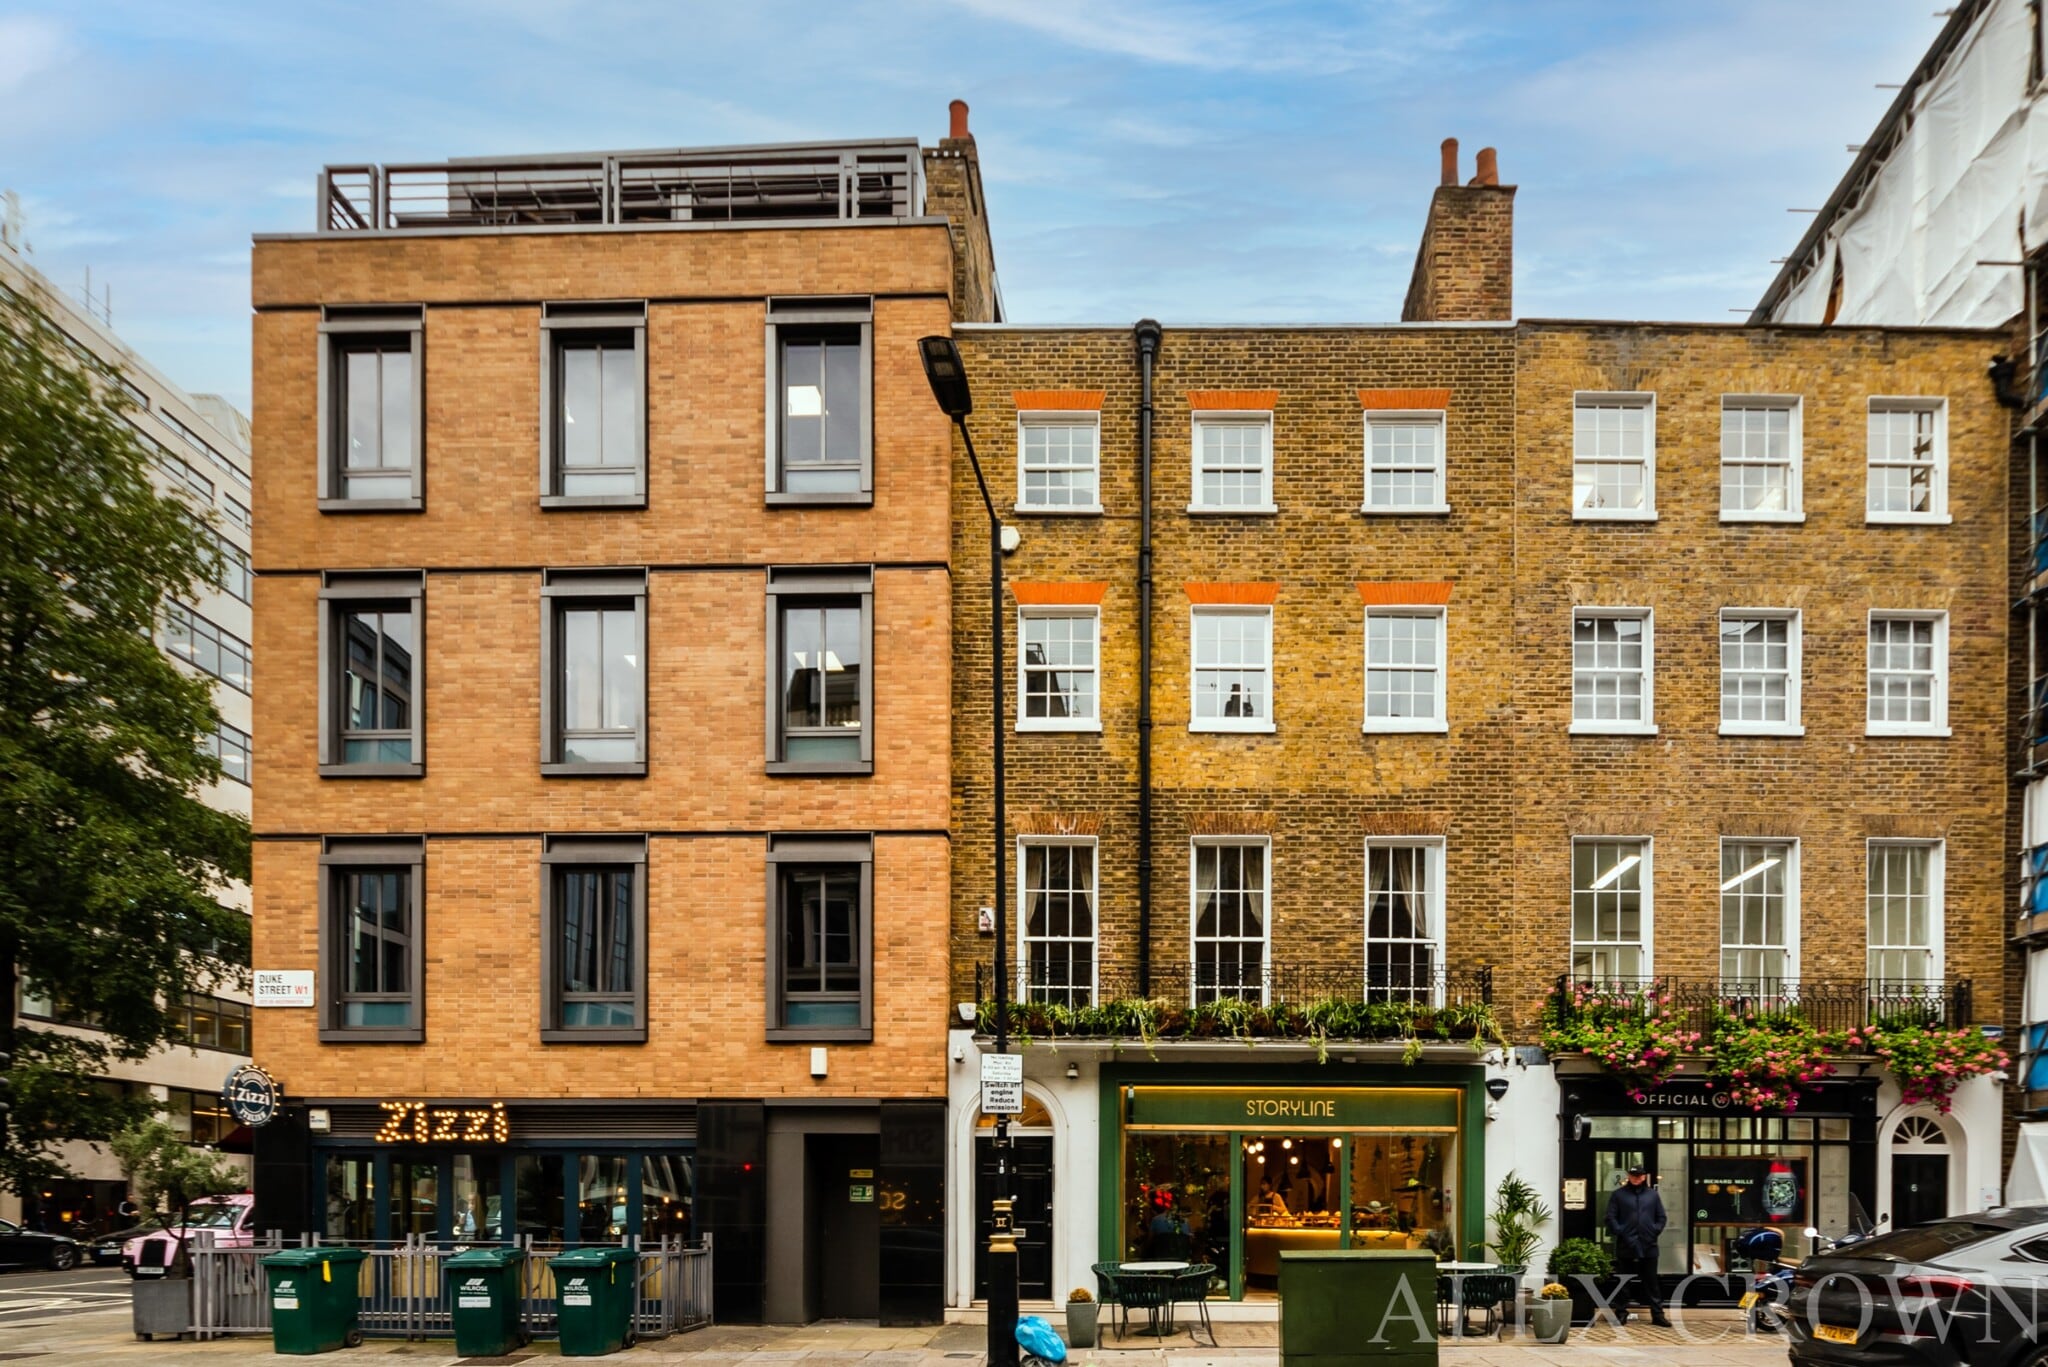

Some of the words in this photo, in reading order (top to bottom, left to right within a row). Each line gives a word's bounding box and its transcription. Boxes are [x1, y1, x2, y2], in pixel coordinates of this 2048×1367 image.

[259, 974, 283, 983] DUKE
[259, 985, 291, 995] STREET
[294, 985, 308, 995] W1
[237, 1087, 270, 1106] Zizzi
[1636, 1094, 1708, 1106] OFFICIAL
[1246, 1099, 1335, 1117] STORYLINE
[375, 1102, 508, 1142] Zizzi
